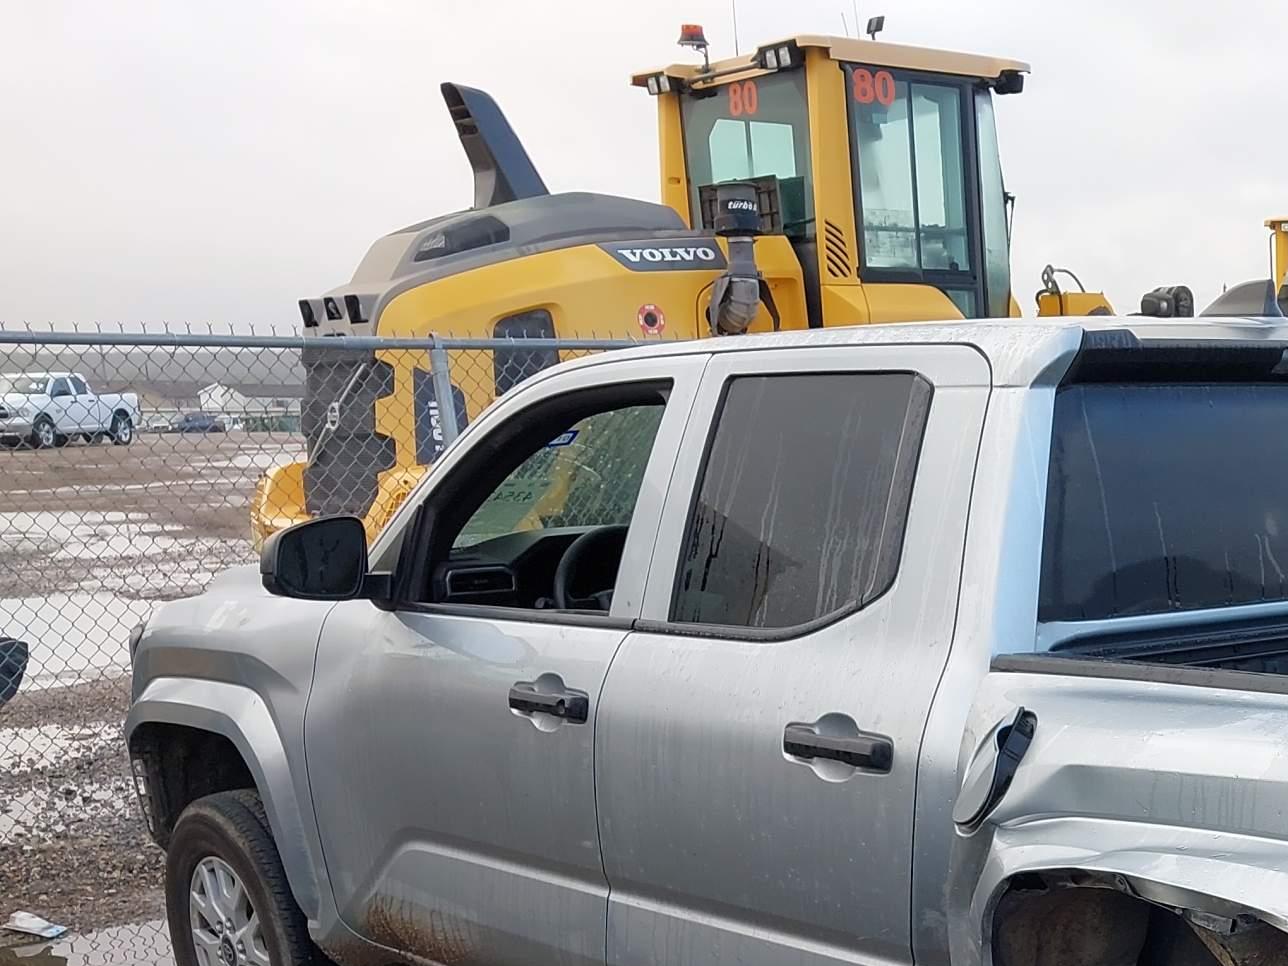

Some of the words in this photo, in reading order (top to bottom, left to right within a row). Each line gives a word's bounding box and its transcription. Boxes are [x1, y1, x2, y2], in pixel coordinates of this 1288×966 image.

[728, 81, 758, 116] 80
[852, 68, 896, 106] 80
[618, 246, 715, 262] VOLVO
